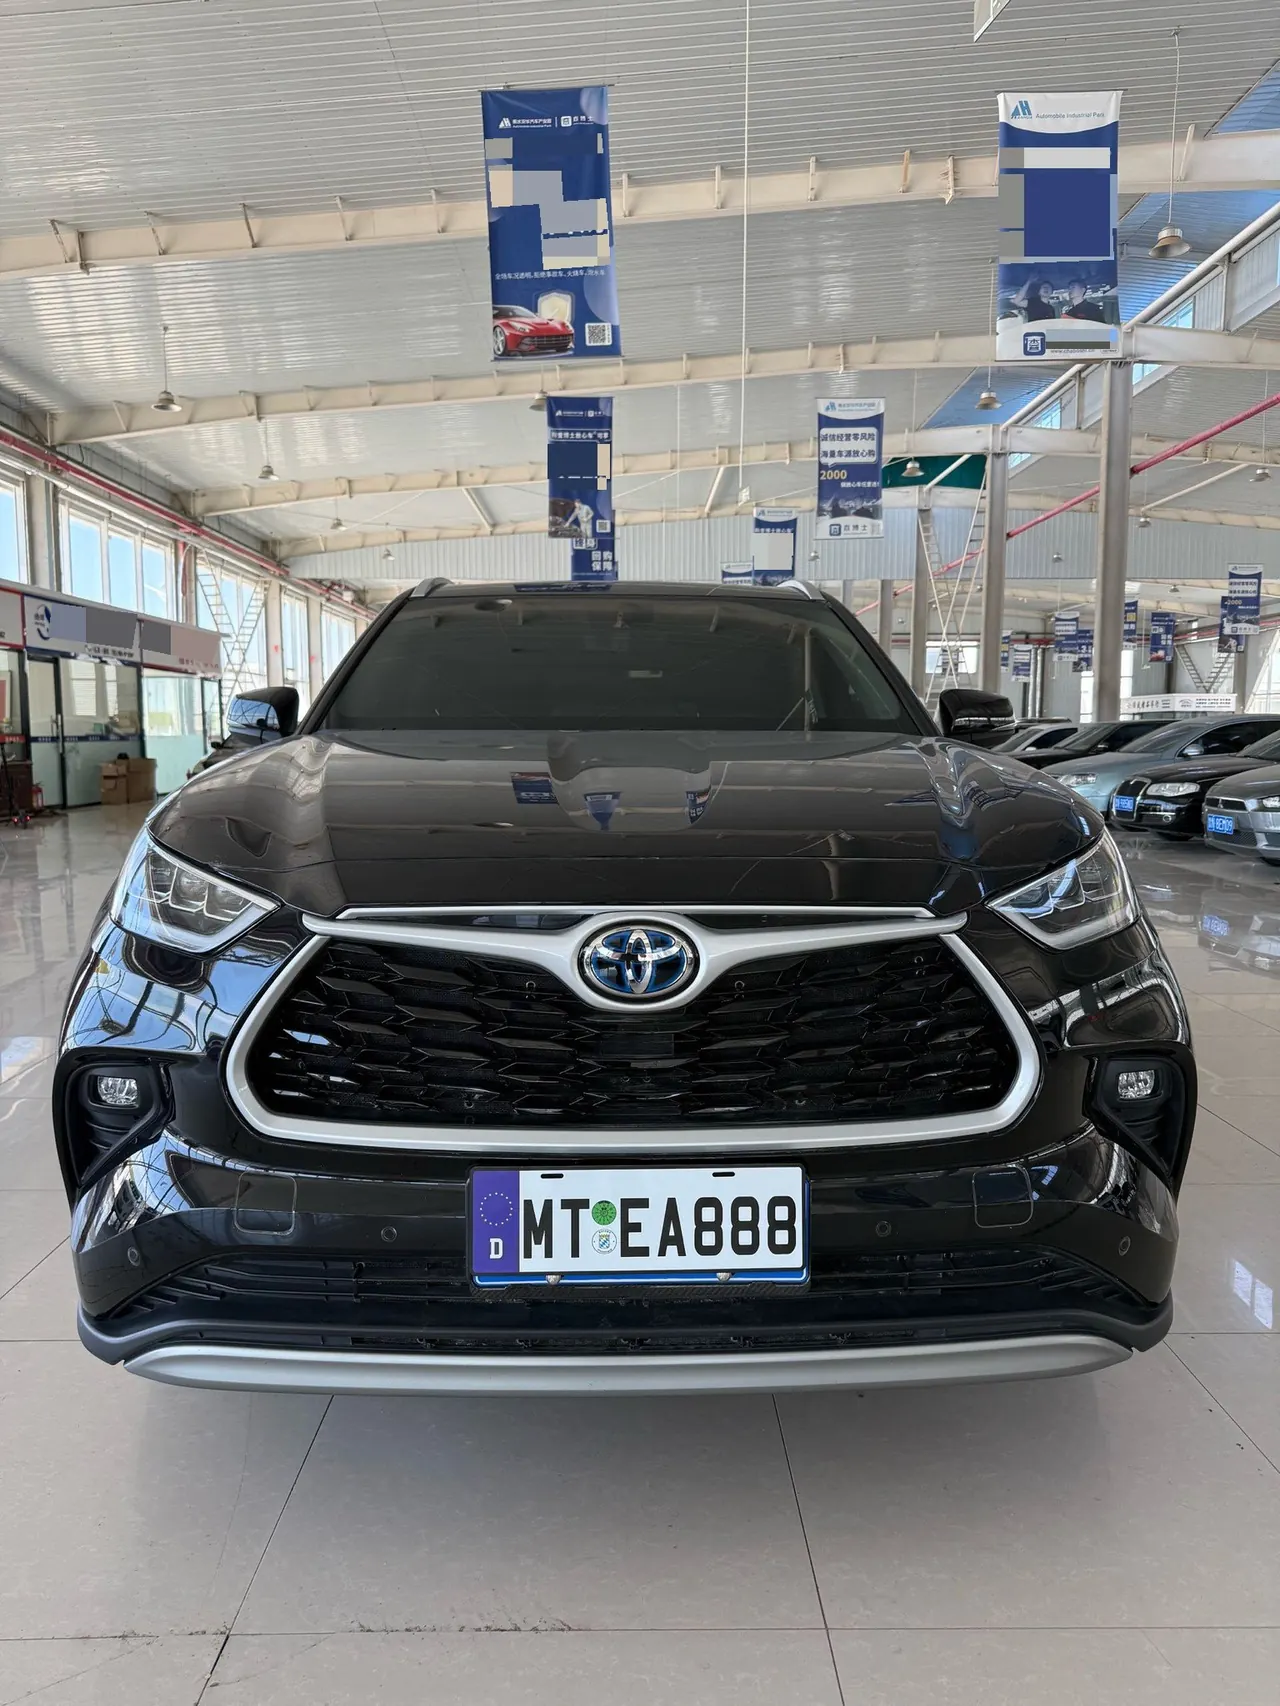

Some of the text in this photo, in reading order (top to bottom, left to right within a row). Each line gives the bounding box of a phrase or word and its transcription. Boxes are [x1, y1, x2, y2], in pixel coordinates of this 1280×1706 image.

[820, 433, 875, 441] 诚信经营零风险
[821, 450, 875, 458] 海量车源放心购
[820, 470, 847, 480] 2000
[489, 1196, 797, 1259] D MT EA888
